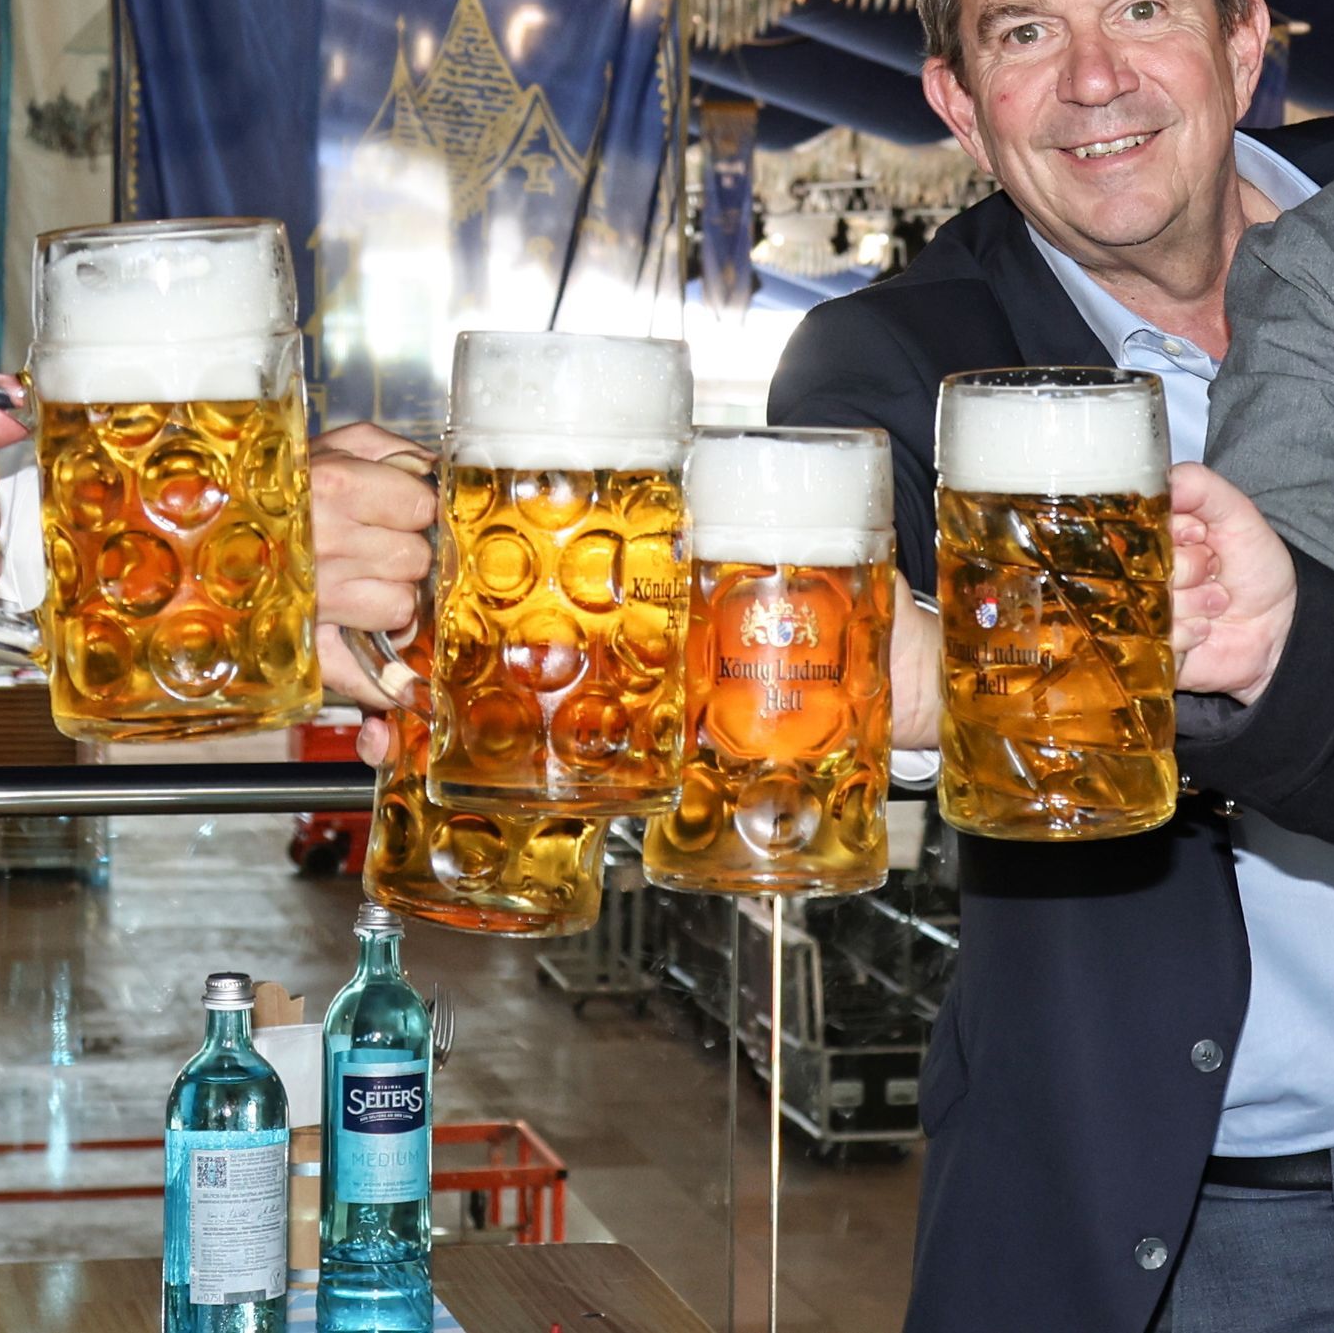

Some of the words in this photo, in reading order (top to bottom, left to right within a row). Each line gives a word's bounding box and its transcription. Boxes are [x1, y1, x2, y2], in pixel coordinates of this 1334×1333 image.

[715, 655, 778, 690] König
[776, 658, 845, 688] Ludwig
[972, 671, 1009, 702] Hell
[759, 687, 803, 719] Hell
[346, 1085, 423, 1115] SELTERS
[351, 1149, 419, 1168] MEDIUM
